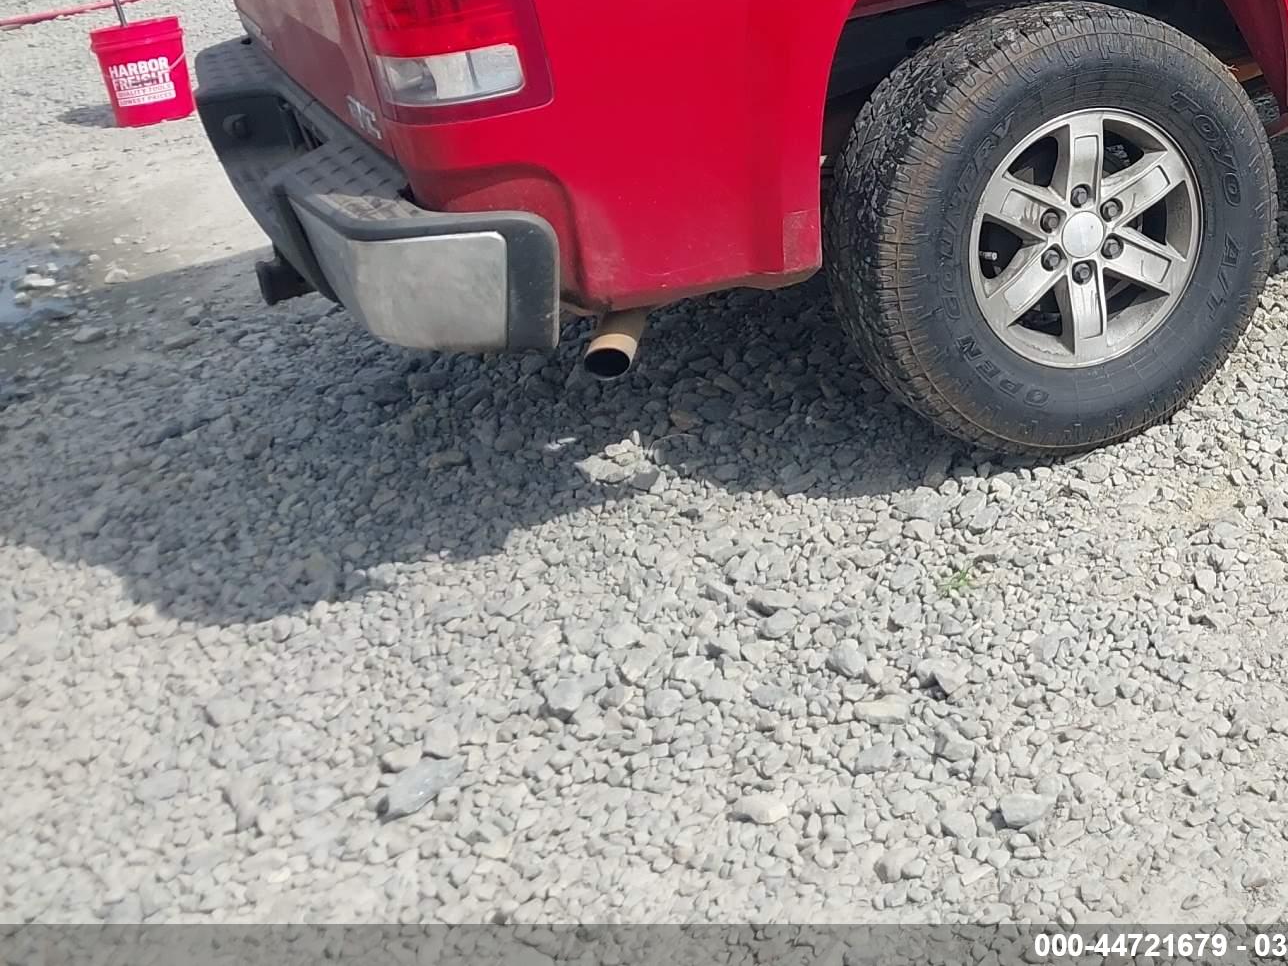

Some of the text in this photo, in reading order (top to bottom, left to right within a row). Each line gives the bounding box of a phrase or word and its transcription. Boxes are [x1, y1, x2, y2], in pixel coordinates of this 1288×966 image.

[108, 56, 169, 78] HARBOR
[112, 68, 171, 91] FREIGHT
[1169, 90, 1241, 207] TOYO
[954, 334, 1050, 408] OPEN
